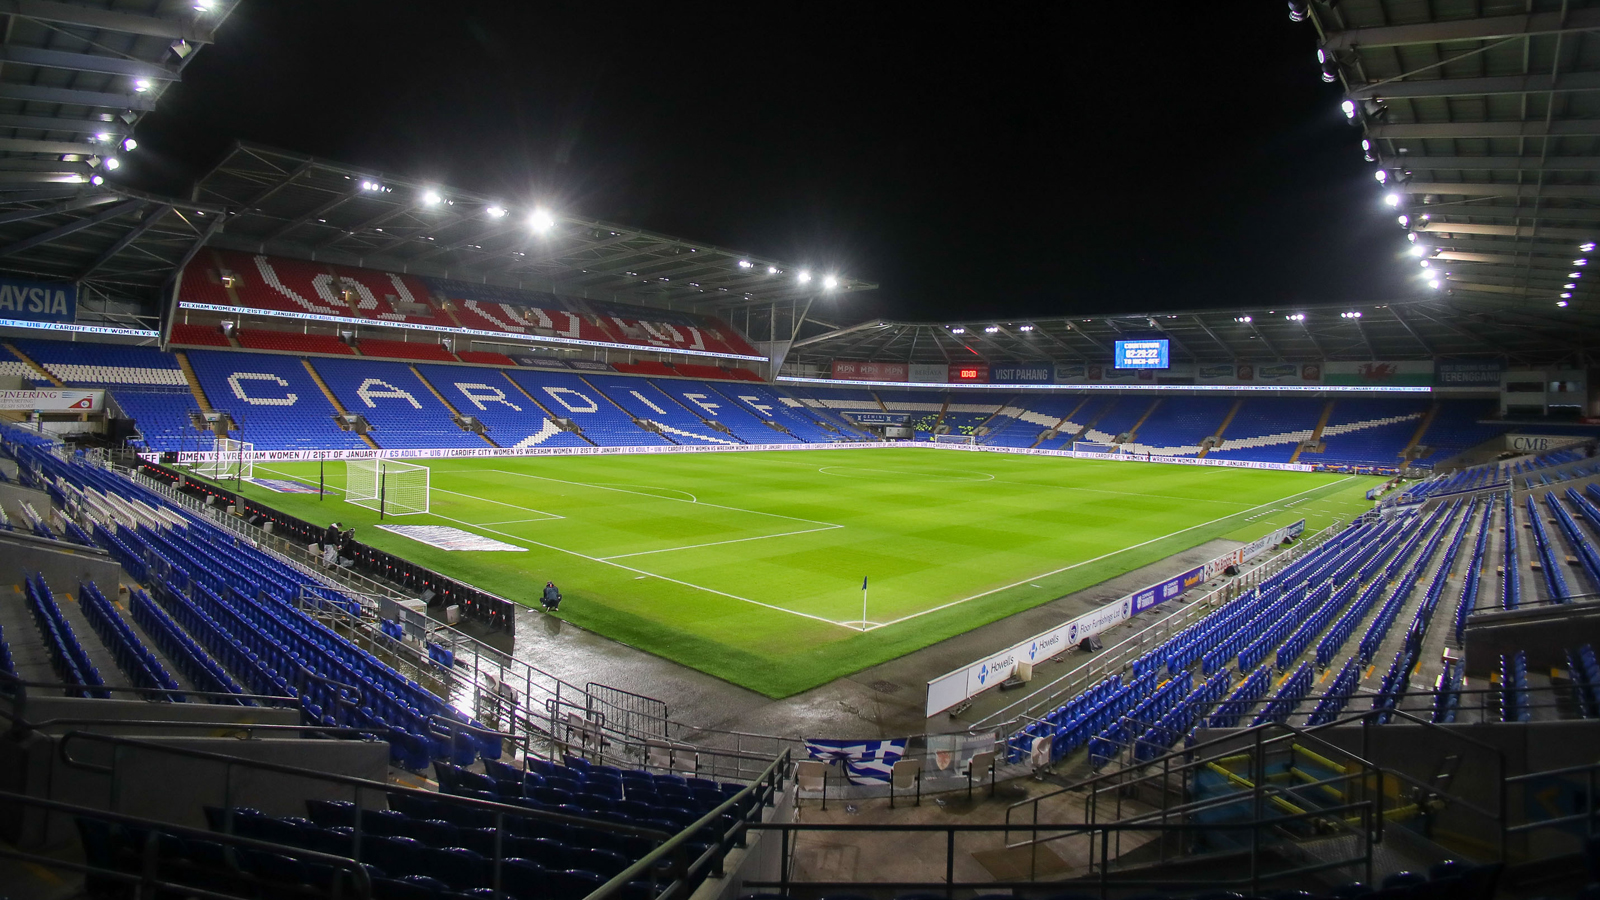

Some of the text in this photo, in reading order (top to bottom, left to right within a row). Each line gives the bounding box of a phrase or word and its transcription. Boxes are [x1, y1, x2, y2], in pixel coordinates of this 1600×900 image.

[0, 284, 67, 315] AYSIA
[212, 304, 237, 312] WOMEN
[273, 310, 299, 318] JANUARY
[54, 324, 88, 333] CARDIFF
[110, 328, 140, 336] WOMEN
[961, 370, 977, 378] 00:00
[996, 369, 1014, 380] VISIT
[1016, 369, 1047, 380] PAHANG
[1441, 372, 1500, 382] TERENGGANU
[1513, 437, 1549, 450] CMB
[209, 452, 219, 460] VS
[223, 451, 267, 461] WREXHAM
[269, 450, 300, 459] WOMEN
[313, 451, 331, 459] 21ST
[346, 450, 377, 458] JANUARY
[390, 450, 399, 458] £5
[430, 449, 440, 457] U16
[451, 449, 475, 457] CARDIFF
[478, 448, 491, 456] CITY
[493, 448, 514, 456] WOMEN
[553, 447, 572, 455] WOMEN
[1226, 459, 1249, 467] JANUARY
[1080, 608, 1121, 634] Floor Furnishings Ltd
[1039, 634, 1059, 650] Howells
[991, 655, 1014, 673] Howells
